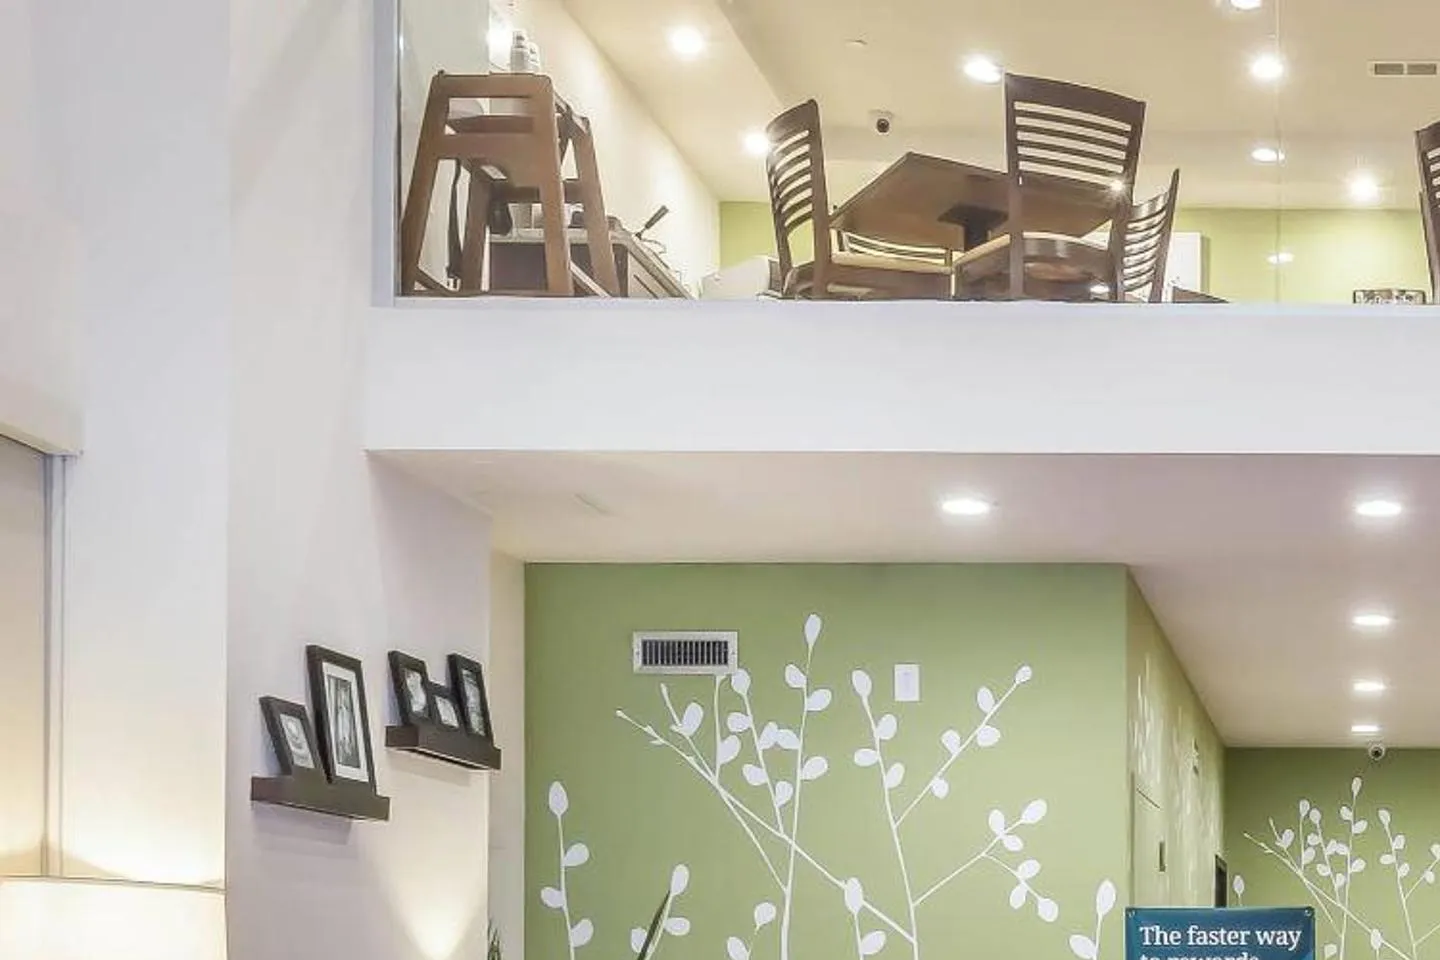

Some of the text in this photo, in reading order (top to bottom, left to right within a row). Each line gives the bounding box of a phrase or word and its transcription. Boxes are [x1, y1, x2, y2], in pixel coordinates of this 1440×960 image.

[1139, 925, 1302, 951] The faster way
